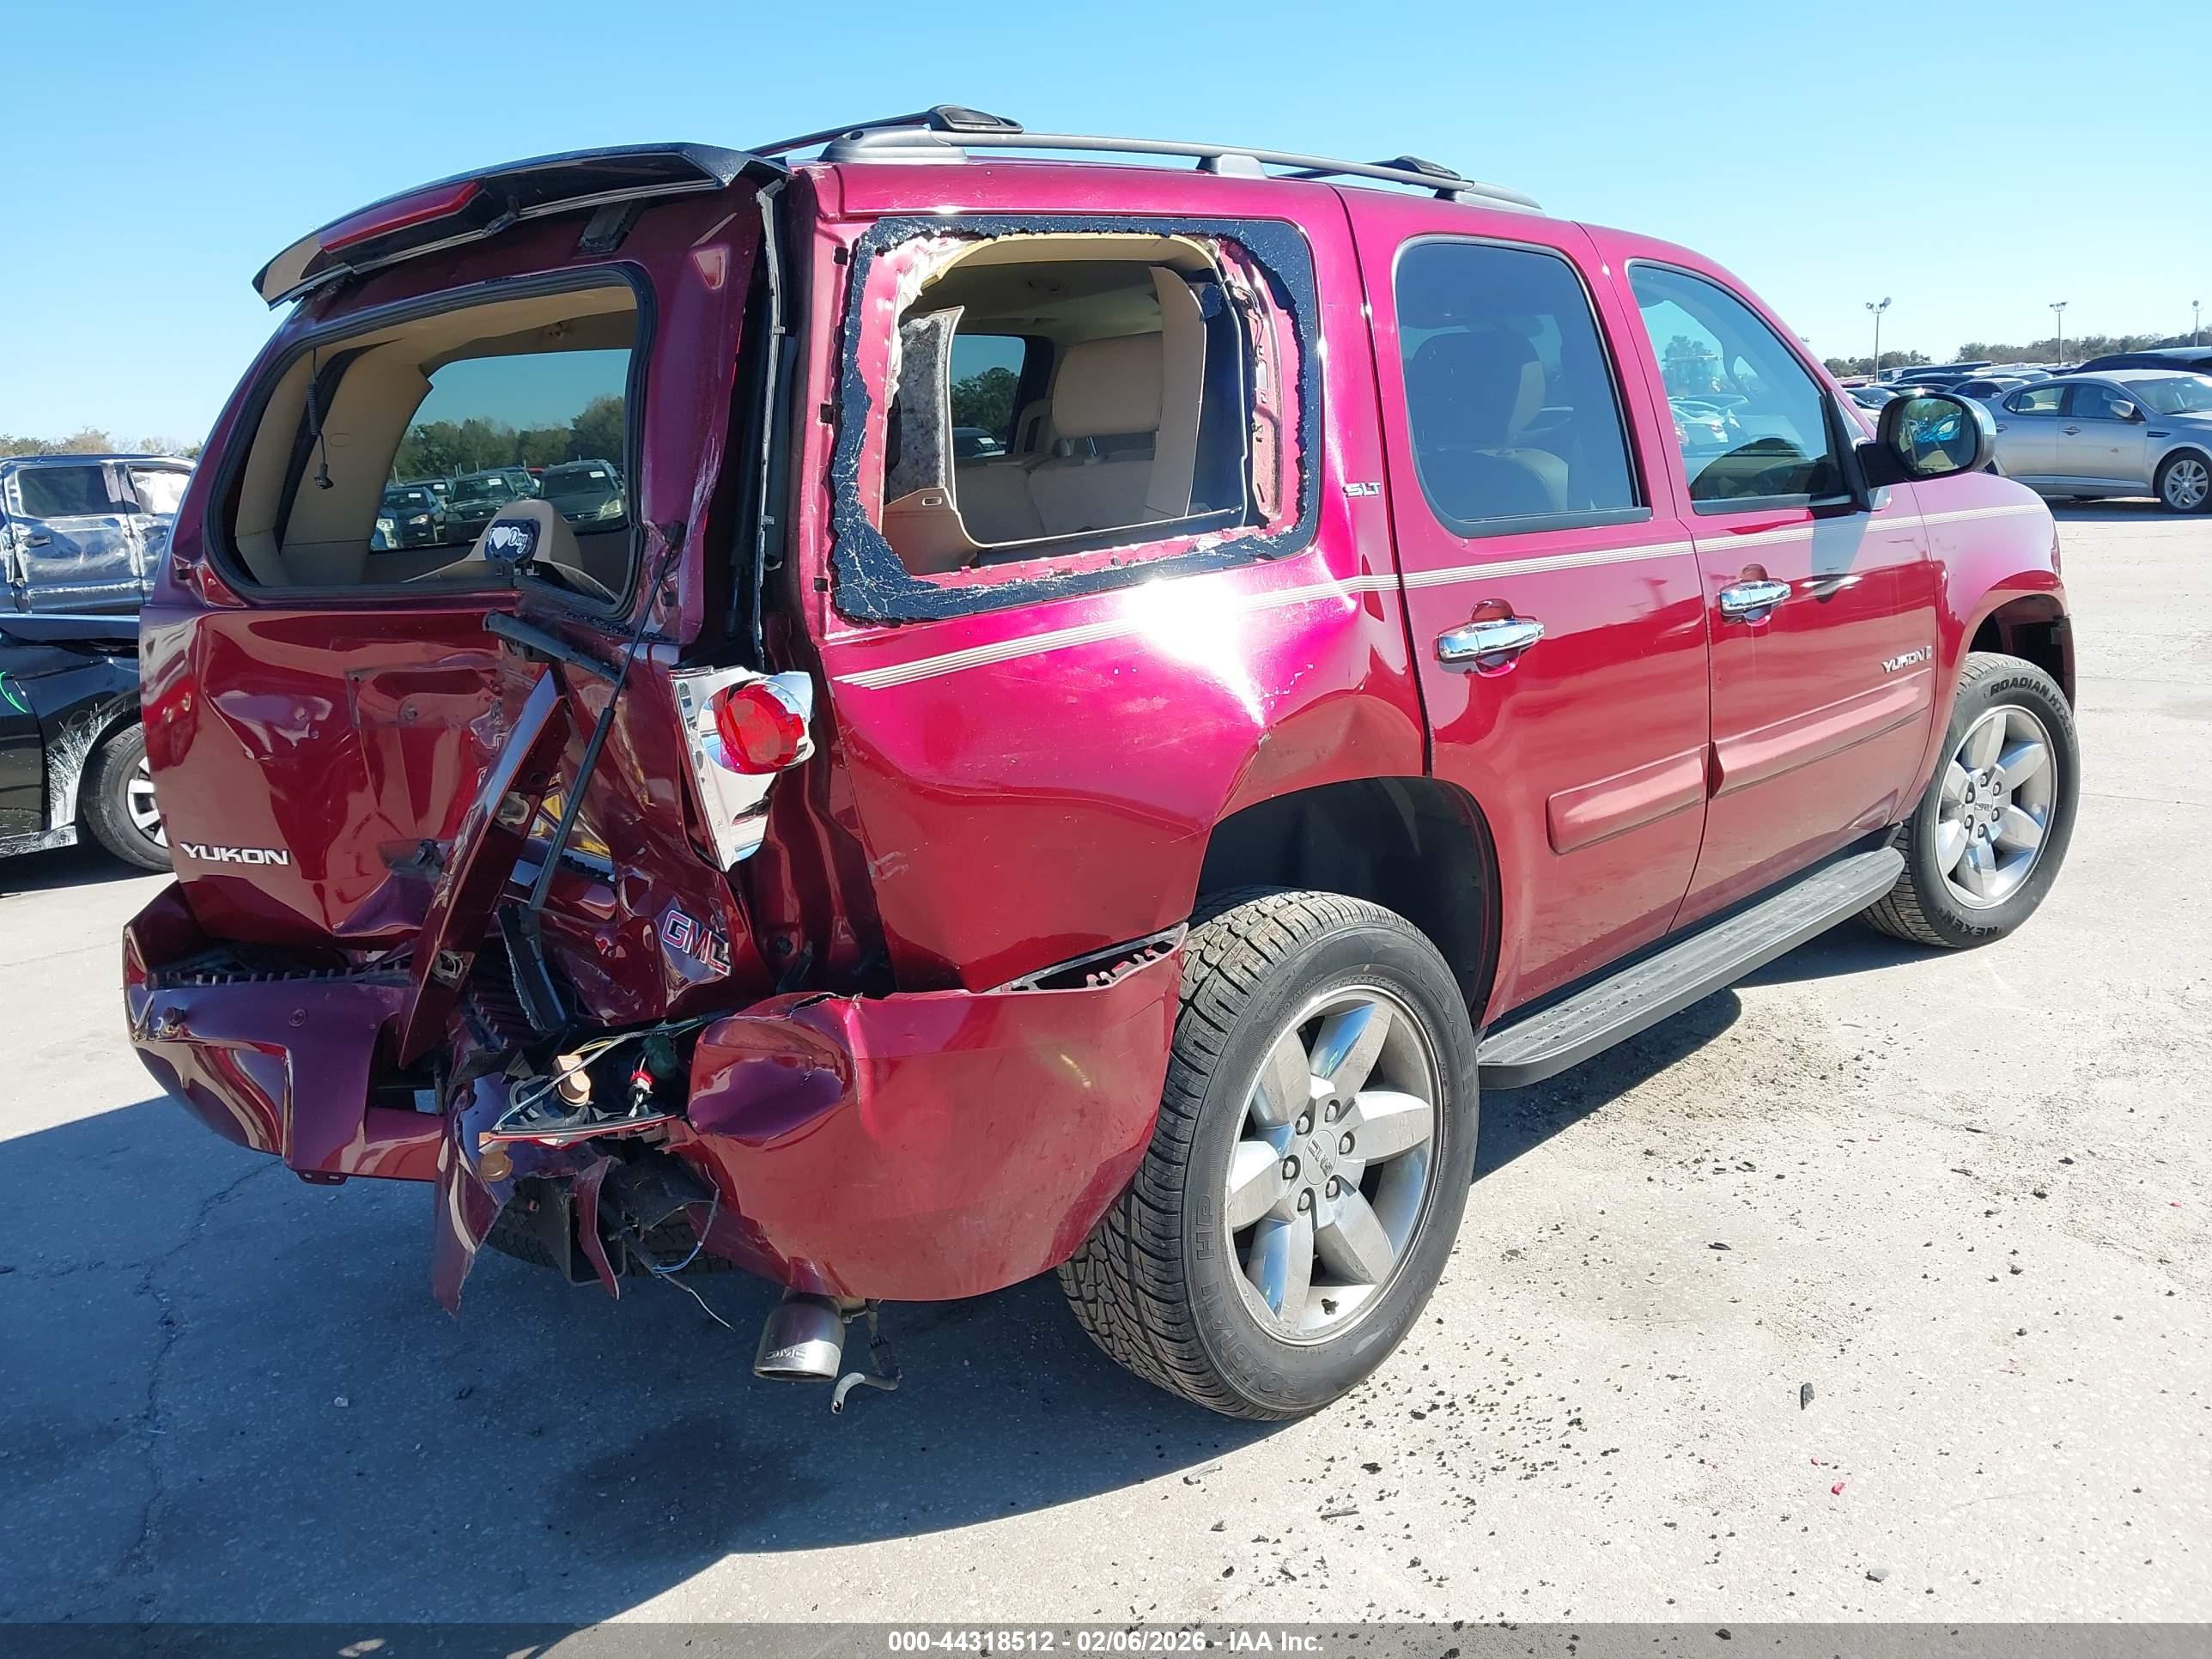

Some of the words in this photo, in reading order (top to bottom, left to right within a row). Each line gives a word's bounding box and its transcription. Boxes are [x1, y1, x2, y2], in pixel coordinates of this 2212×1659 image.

[1344, 482, 1381, 496] SLT
[1882, 648, 1924, 674] YUKON
[1989, 677, 2051, 697] ROADIAN
[179, 842, 290, 866] YUKON
[1940, 908, 1999, 937] NEXEN
[662, 909, 732, 976] GMC
[1195, 1194, 1216, 1261] HP
